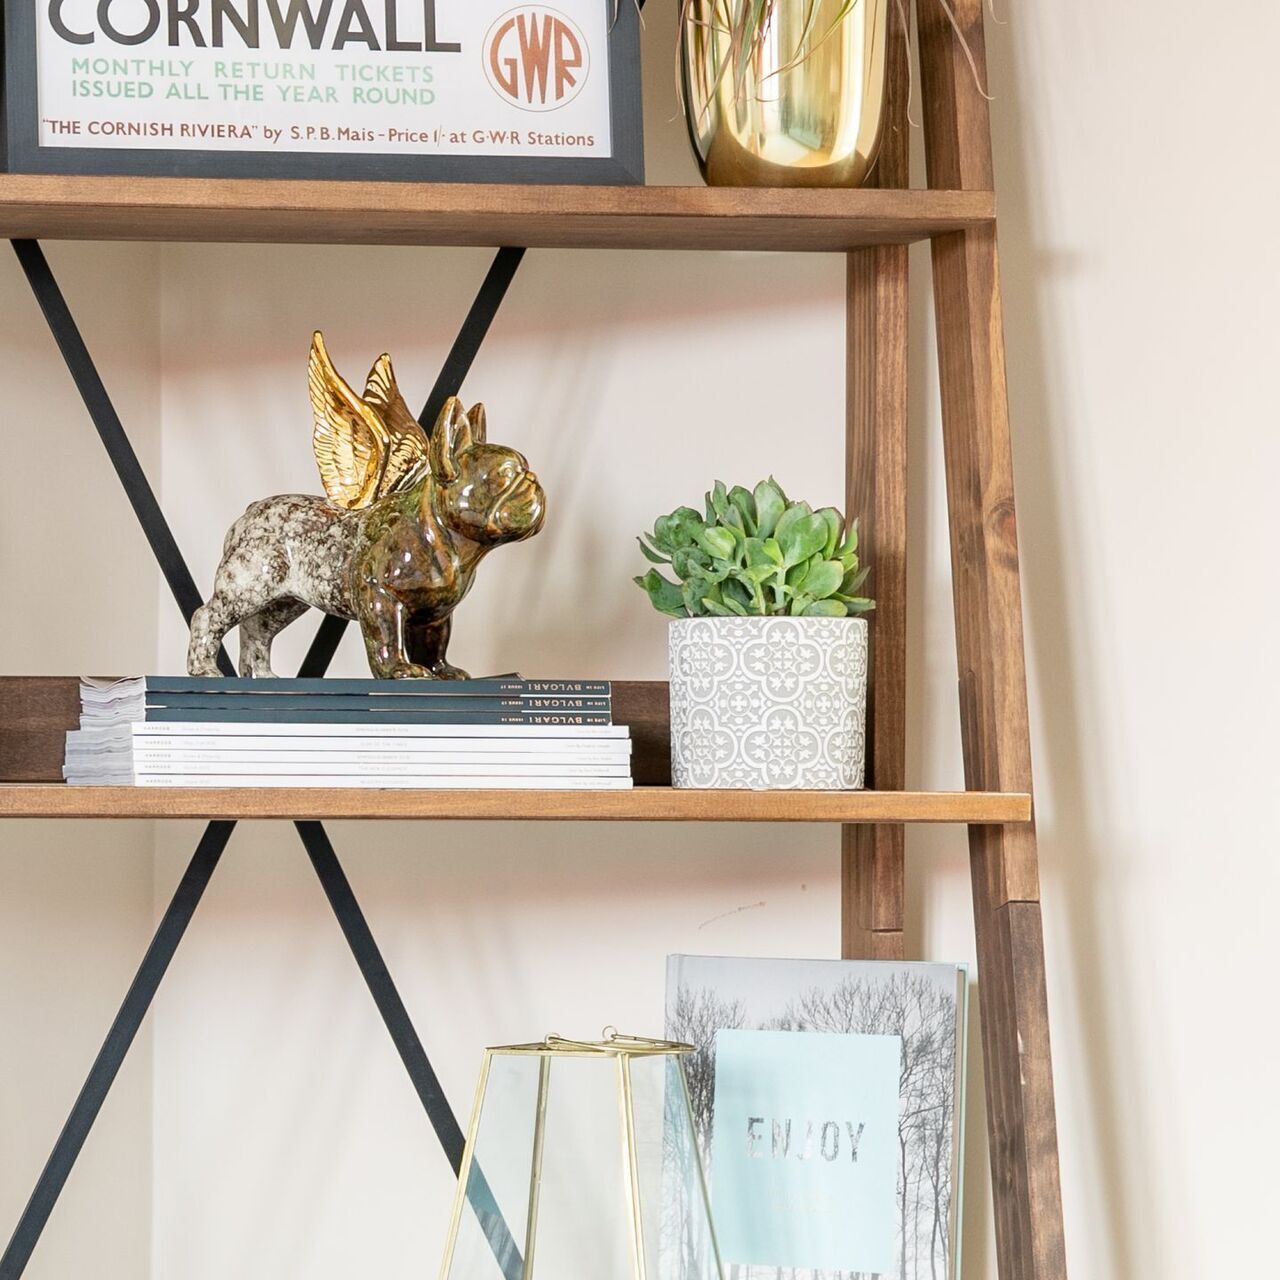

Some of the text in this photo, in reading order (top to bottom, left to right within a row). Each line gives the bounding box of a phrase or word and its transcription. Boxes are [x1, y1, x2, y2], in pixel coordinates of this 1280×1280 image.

[71, 58, 434, 84] MONTHLY RETURN TICKETS
[489, 12, 583, 104] GWR
[71, 80, 436, 106] ISSUED ALL THE YEAR ROUND
[87, 121, 173, 137] CORNISH
[263, 125, 283, 144] by
[449, 130, 467, 144] at
[528, 131, 595, 147] Stations
[528, 683, 582, 691] BVLGARI
[529, 699, 583, 707] BVLGARI
[529, 716, 583, 724] BVLGARI
[747, 1116, 865, 1162] ENJOY
